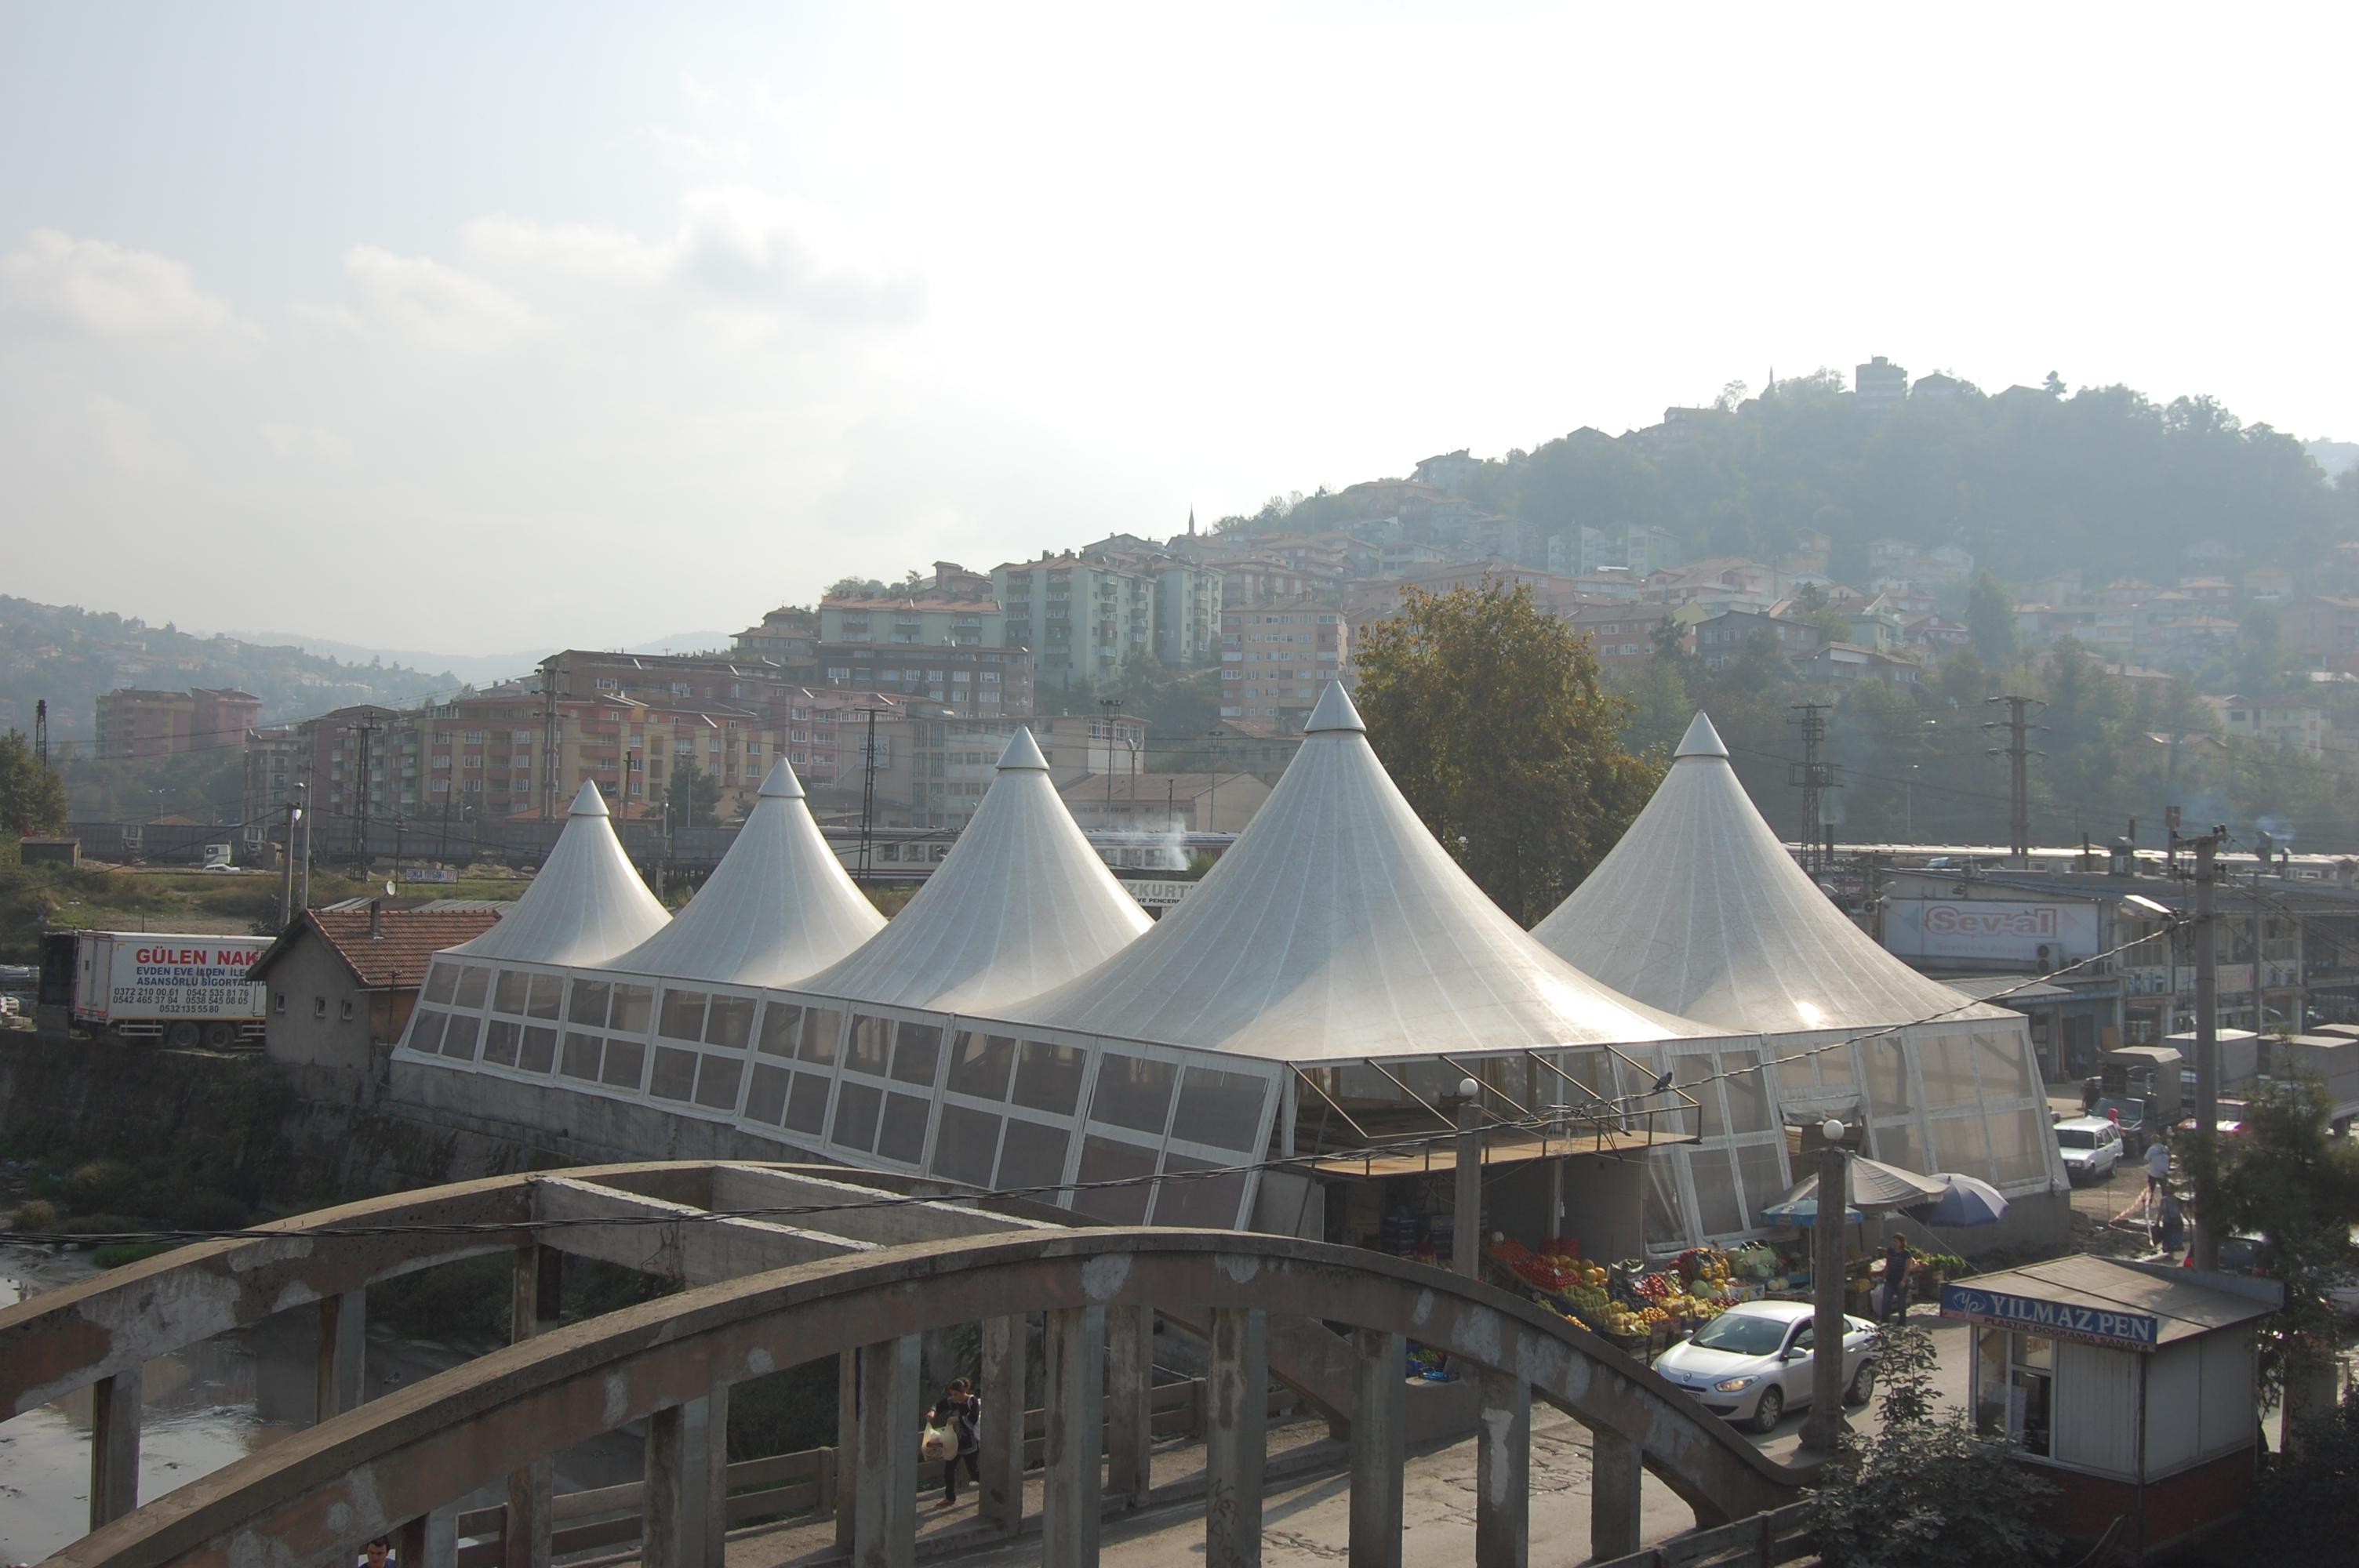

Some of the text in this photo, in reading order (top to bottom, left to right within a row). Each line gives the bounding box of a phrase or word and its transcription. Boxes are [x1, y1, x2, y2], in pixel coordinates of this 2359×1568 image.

[1127, 883, 1194, 898] ZKURT
[136, 946, 263, 966] GÜLEN NAK
[136, 967, 171, 975] EVDEN
[174, 967, 194, 976] EVE
[1990, 1294, 2150, 1341] YILMAZ PEN
